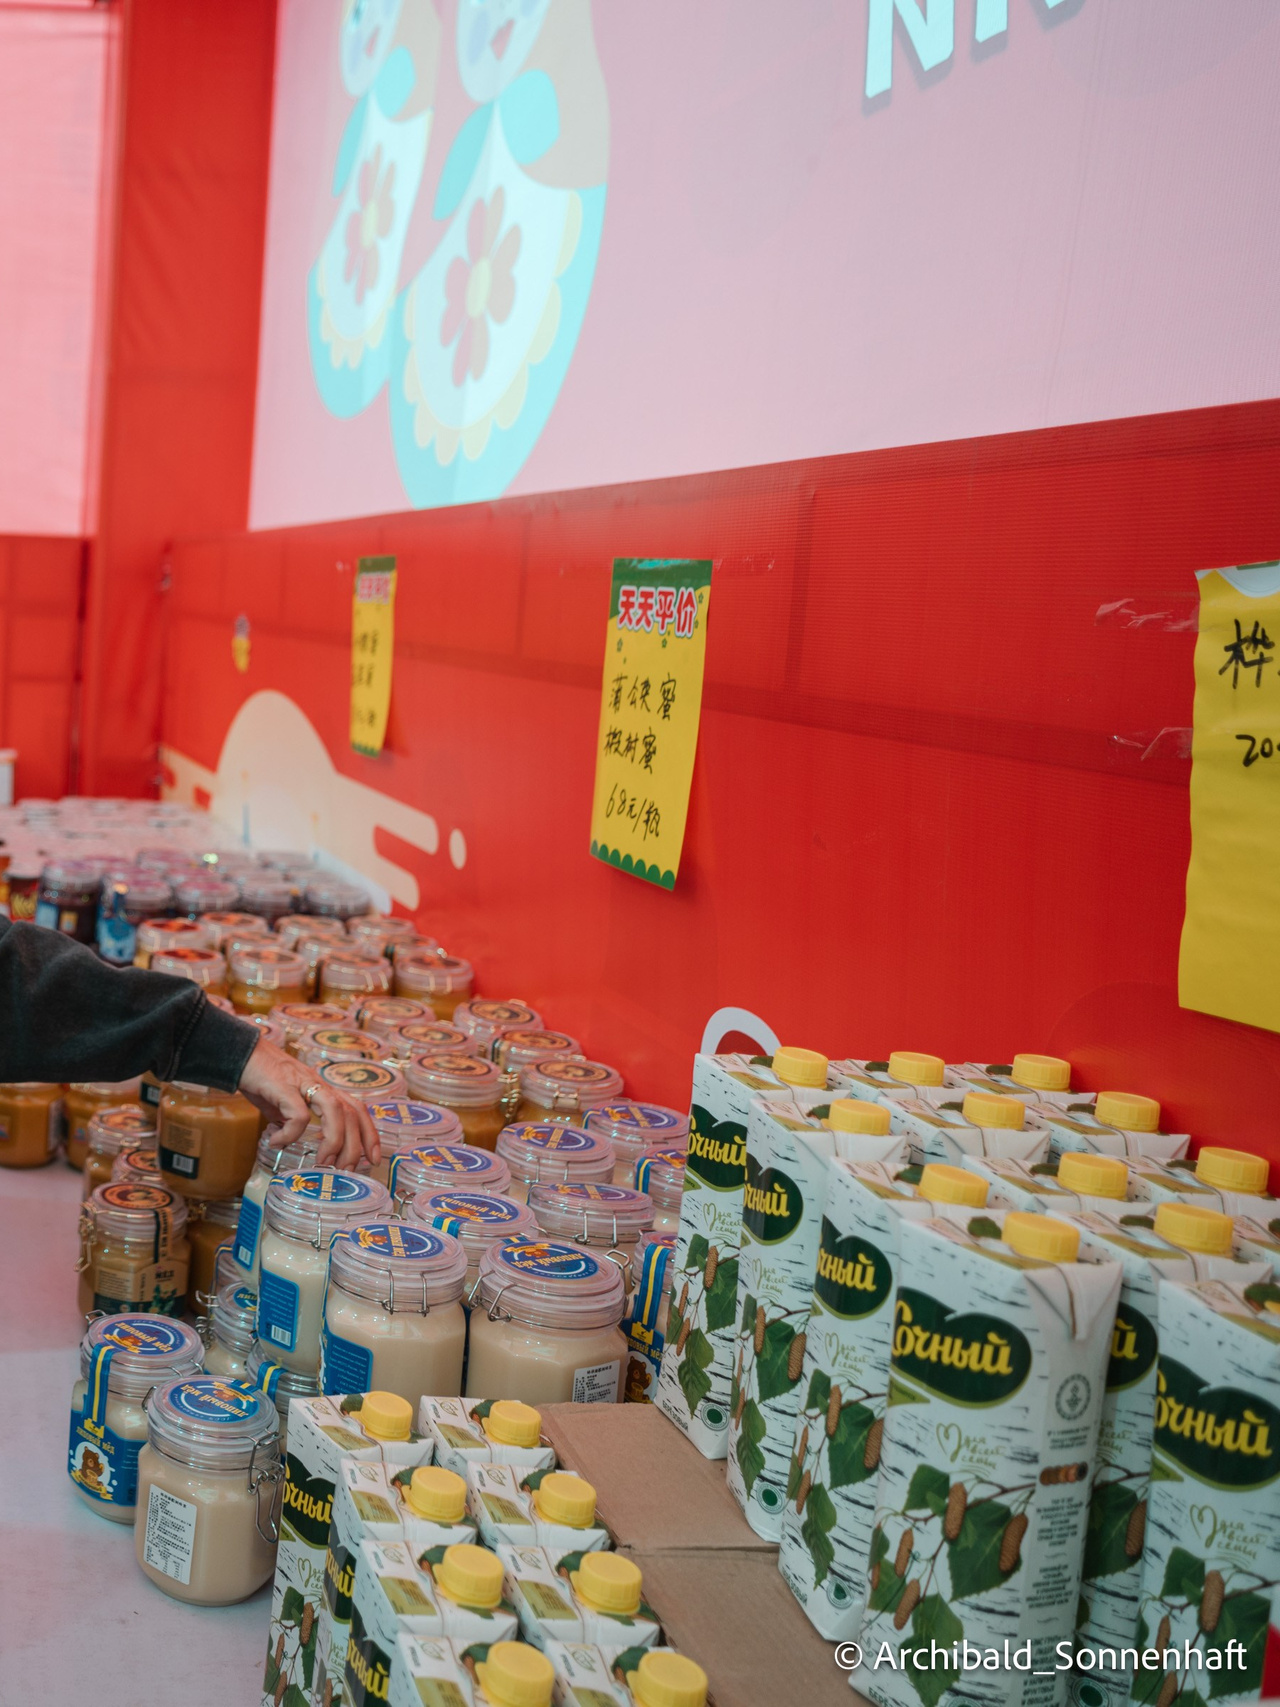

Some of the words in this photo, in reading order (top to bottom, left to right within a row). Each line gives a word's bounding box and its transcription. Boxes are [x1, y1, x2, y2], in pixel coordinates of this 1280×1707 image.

[617, 584, 699, 638] 天天平价
[1235, 734, 1280, 768] 20
